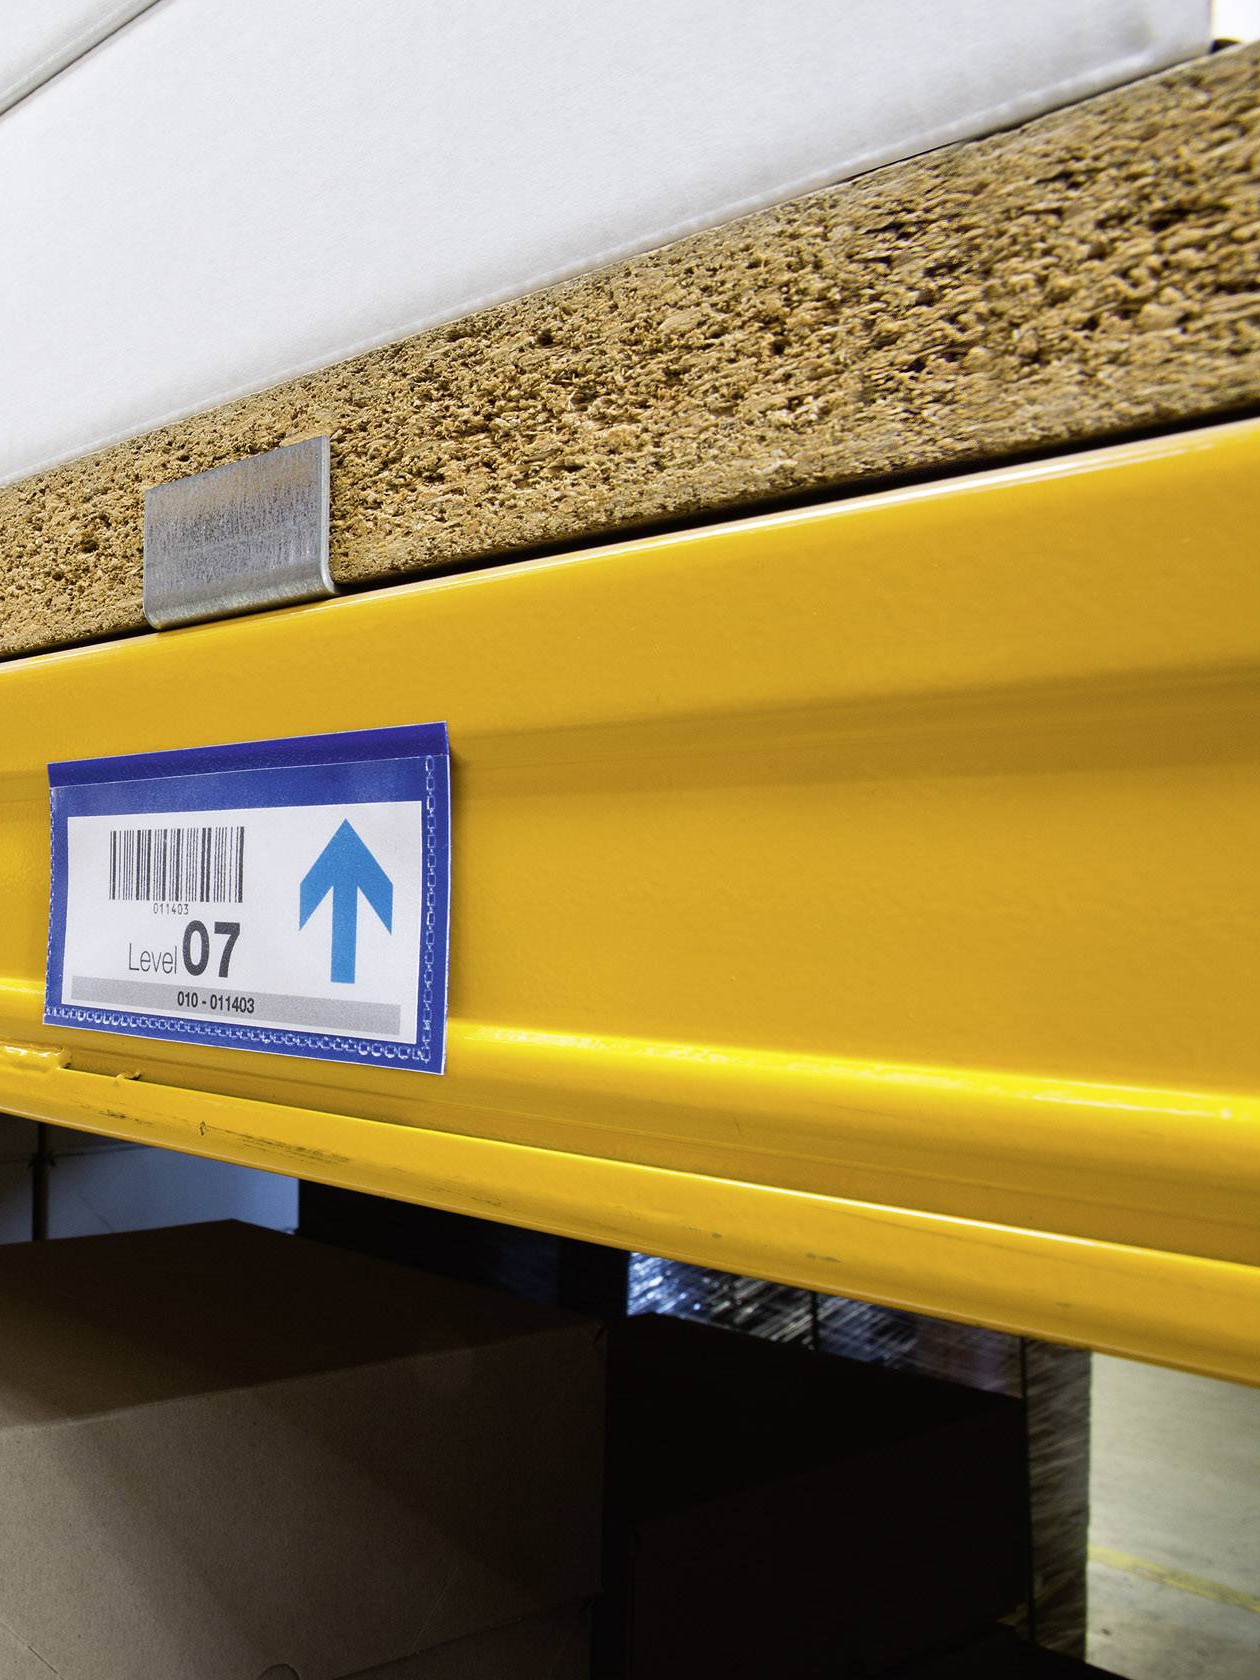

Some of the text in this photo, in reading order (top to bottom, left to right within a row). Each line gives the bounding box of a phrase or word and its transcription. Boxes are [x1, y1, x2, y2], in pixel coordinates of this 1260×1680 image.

[153, 903, 189, 915] 011403
[128, 920, 241, 979] Level 07
[177, 991, 199, 1008] 010
[210, 994, 255, 1014] 011403
